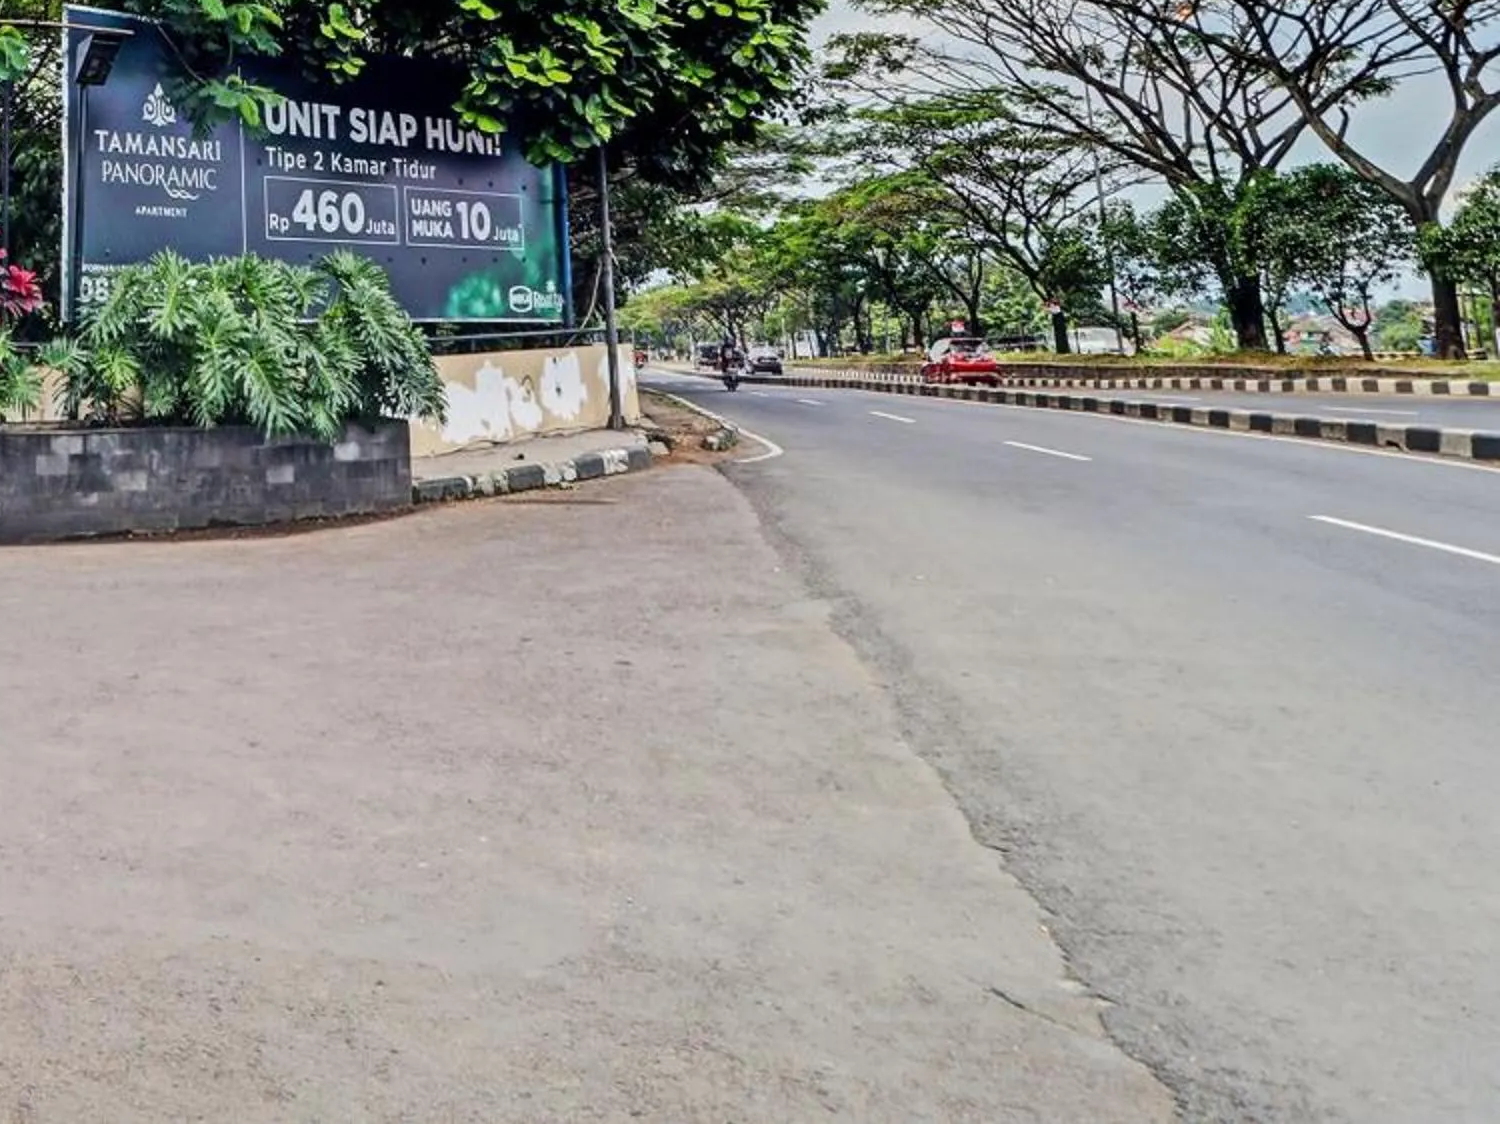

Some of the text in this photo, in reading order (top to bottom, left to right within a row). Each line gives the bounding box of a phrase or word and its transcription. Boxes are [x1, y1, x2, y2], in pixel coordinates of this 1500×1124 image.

[265, 99, 340, 139] UNIT
[350, 107, 417, 147] SIAP
[94, 129, 221, 161] TAMANSARI
[265, 146, 436, 179] Tipe 2 Kamar Tidur
[102, 160, 217, 200] PANORAMIC
[135, 205, 187, 218] APARTMENT
[269, 189, 395, 235] Rp 460 Juta
[411, 198, 453, 217] UANG
[456, 201, 491, 241] 10
[412, 219, 454, 238] MUKA
